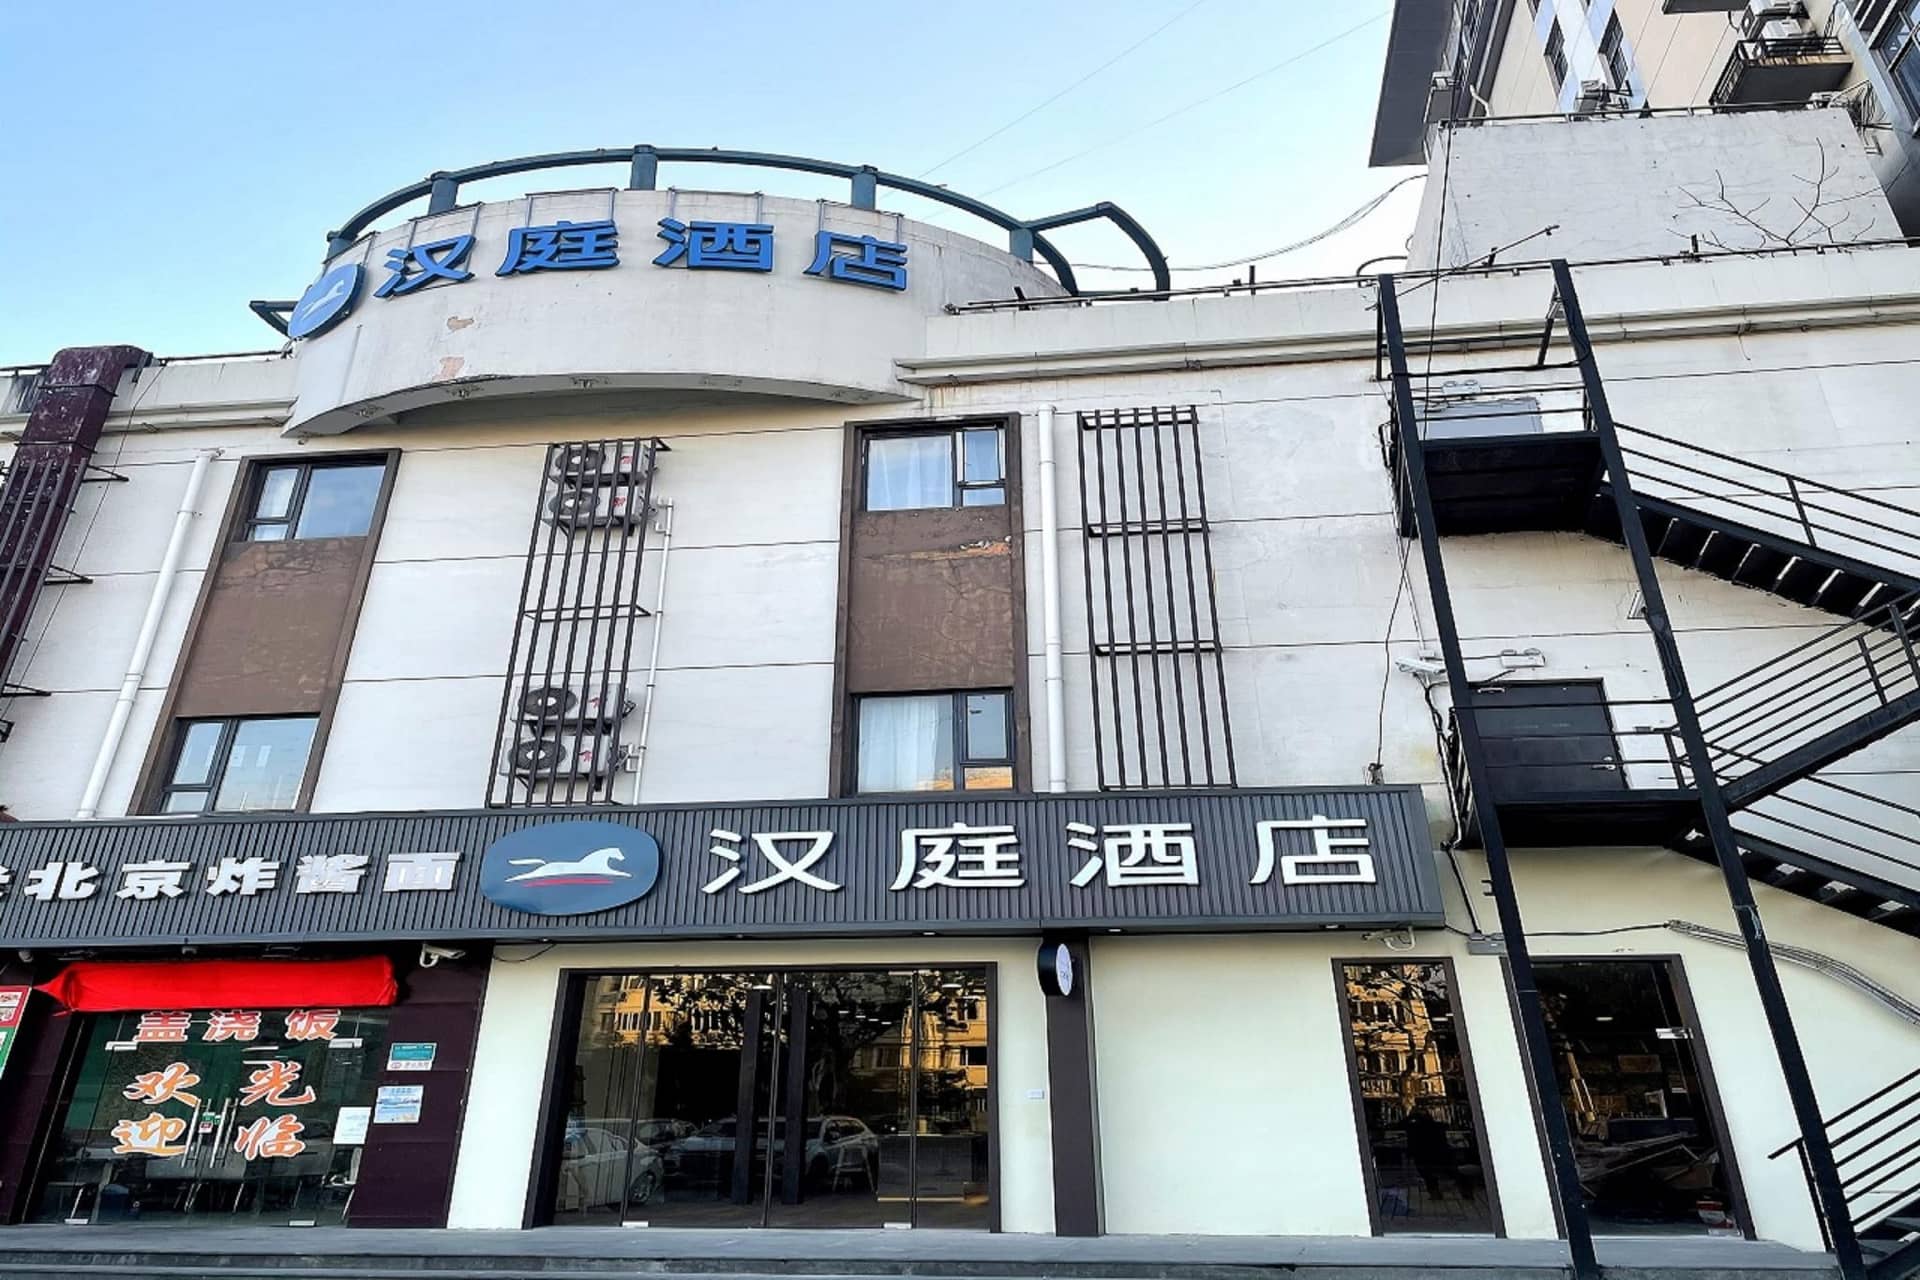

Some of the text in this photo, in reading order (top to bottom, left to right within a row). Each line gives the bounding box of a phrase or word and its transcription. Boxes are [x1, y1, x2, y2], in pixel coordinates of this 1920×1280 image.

[374, 217, 909, 298] 汉庭酒店
[702, 814, 1377, 895] 汉庭酒店
[134, 1009, 342, 1042] 盖浇饭
